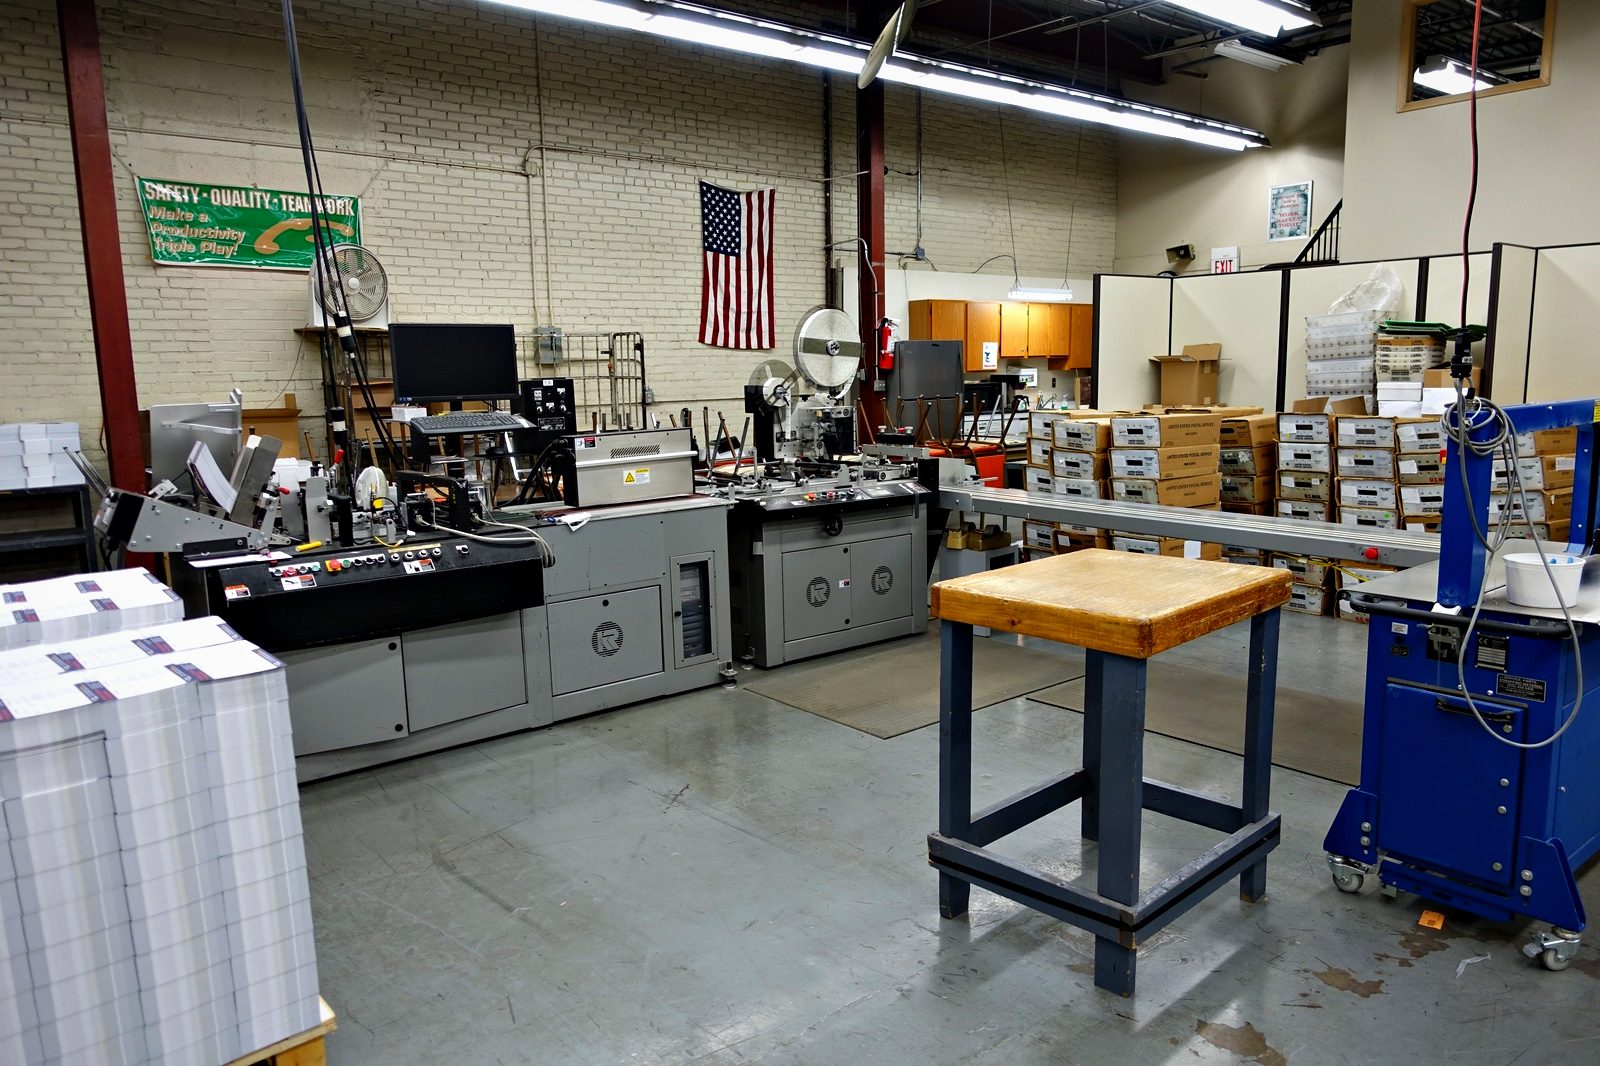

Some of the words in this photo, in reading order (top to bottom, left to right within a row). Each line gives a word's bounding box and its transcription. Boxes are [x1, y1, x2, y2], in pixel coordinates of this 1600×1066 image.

[210, 188, 270, 210] QUALITY
[149, 205, 194, 222] Make
[199, 212, 208, 222] a
[151, 221, 246, 244] Productivity
[154, 236, 196, 255] Triple
[201, 240, 239, 258] Play!
[1215, 259, 1233, 273] EXIT
